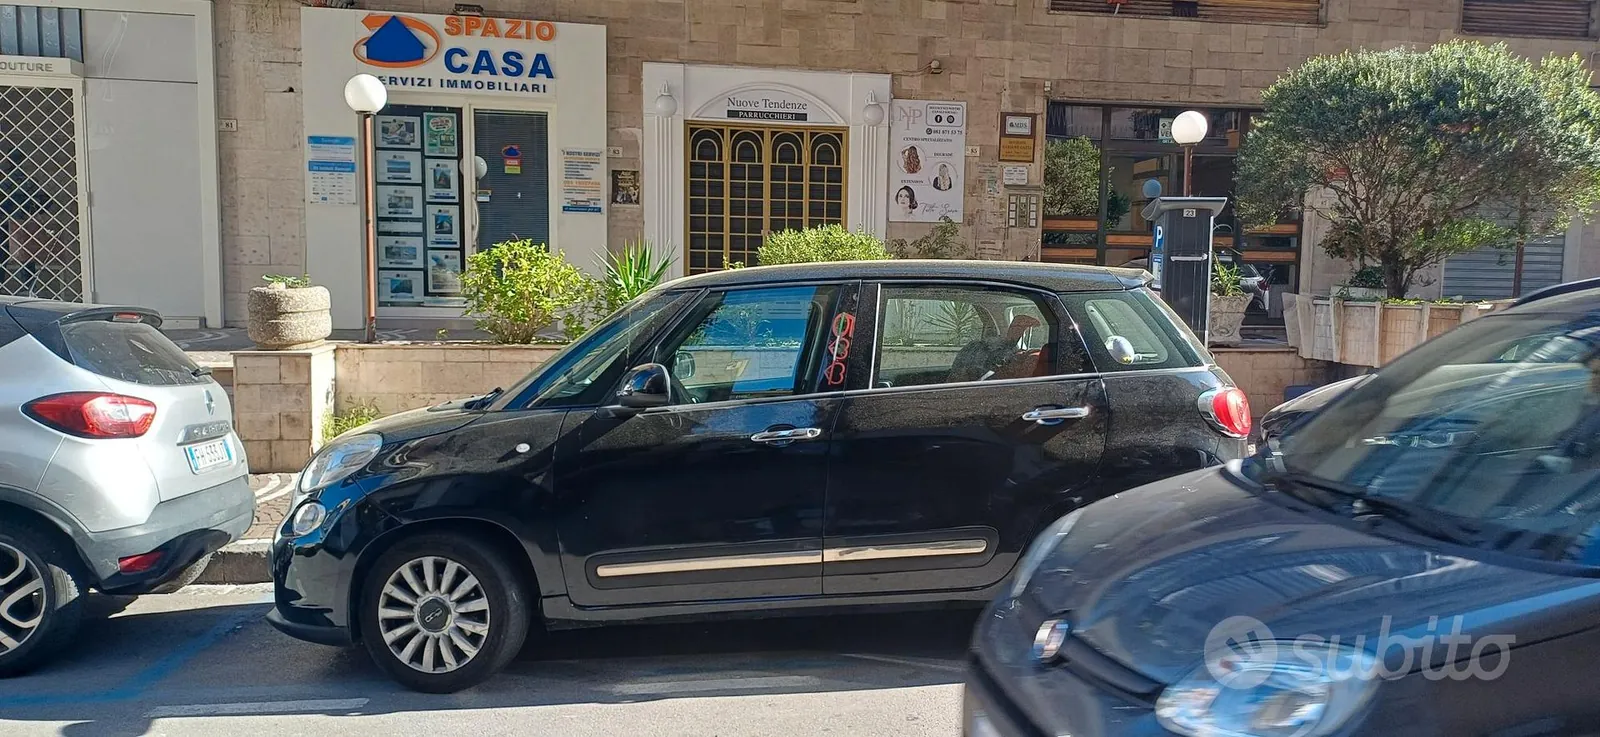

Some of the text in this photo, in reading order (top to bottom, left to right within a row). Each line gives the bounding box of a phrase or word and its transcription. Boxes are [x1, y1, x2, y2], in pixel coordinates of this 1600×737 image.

[444, 16, 557, 41] SPAZIO
[0, 61, 54, 72] OUTURE
[444, 48, 555, 79] CASA
[378, 76, 547, 93] ERVIZI IMMOBILIARI
[727, 97, 808, 110] Nuove Tendenze
[739, 111, 796, 120] PARRUCCHIERI
[1155, 225, 1163, 248] P
